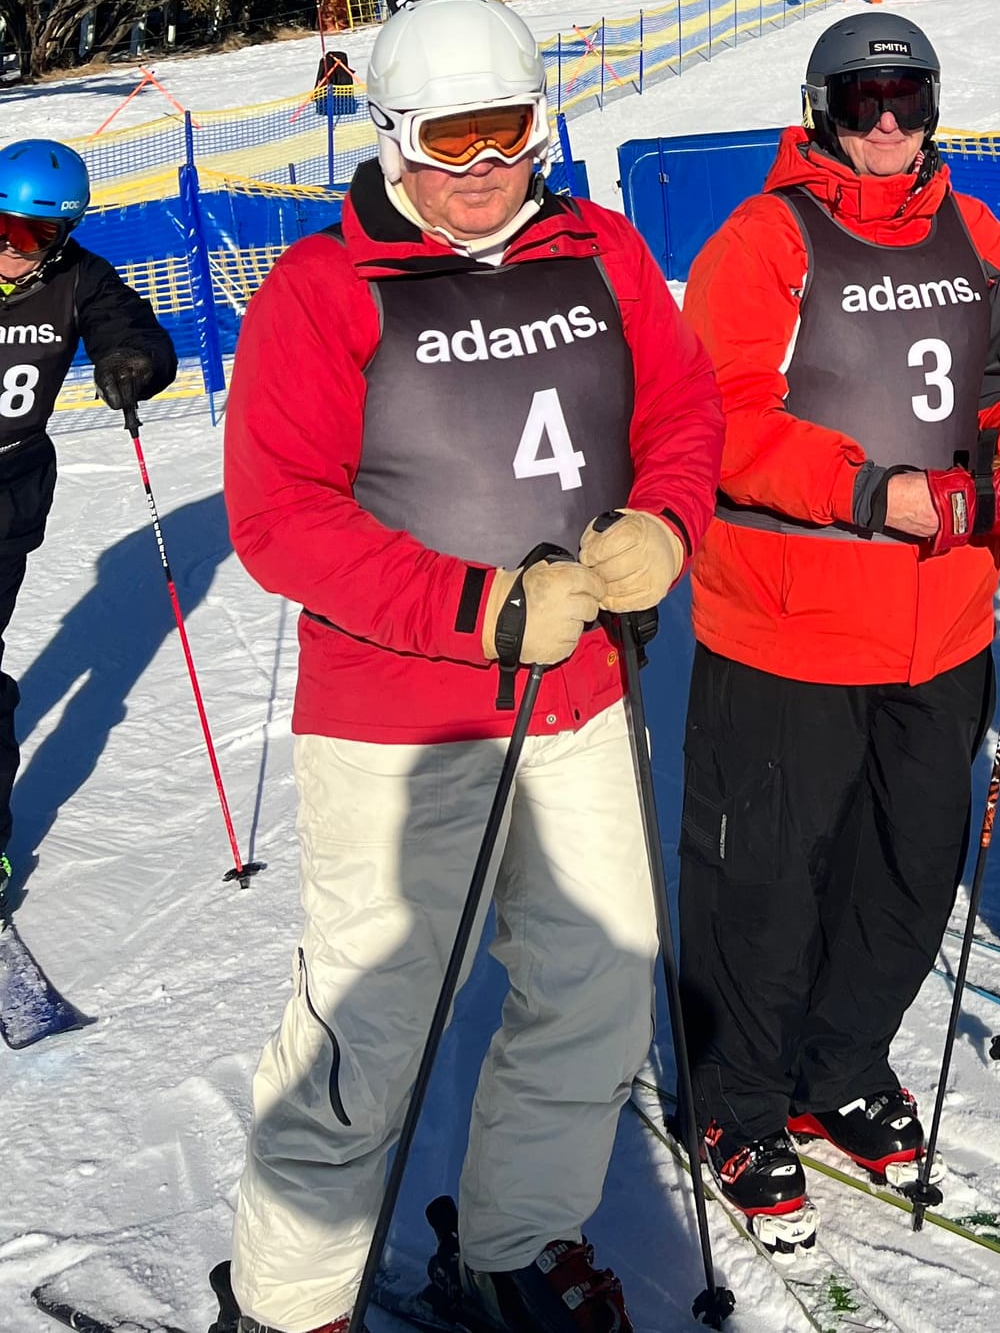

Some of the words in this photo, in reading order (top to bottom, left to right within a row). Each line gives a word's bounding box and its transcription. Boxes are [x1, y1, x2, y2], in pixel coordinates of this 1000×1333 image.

[874, 43, 908, 53] SMITH
[841, 275, 981, 313] adams.
[415, 305, 608, 364] adams.
[0, 364, 40, 418] 8
[907, 338, 955, 423] 3
[513, 387, 586, 491] 4
